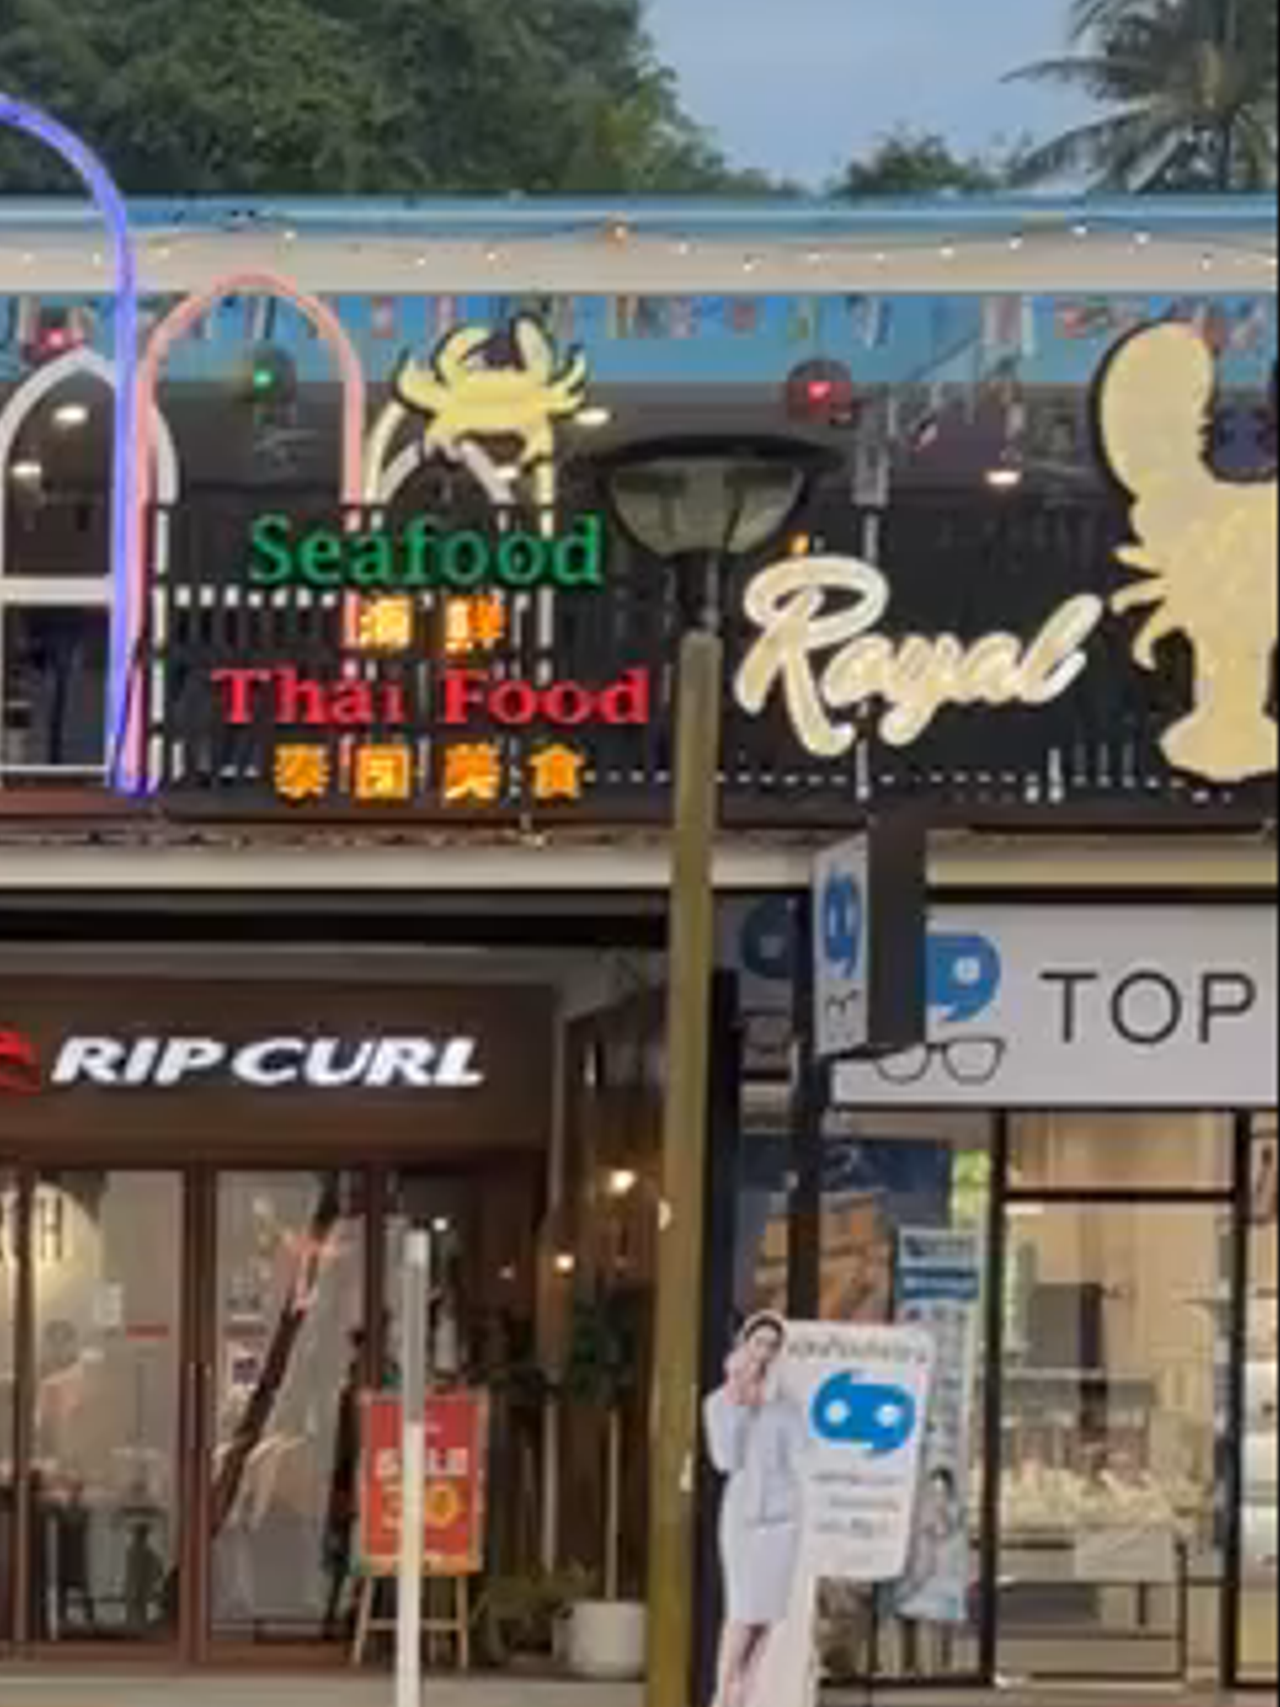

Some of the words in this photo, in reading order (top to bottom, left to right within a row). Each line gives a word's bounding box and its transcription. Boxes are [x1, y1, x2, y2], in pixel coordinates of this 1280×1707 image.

[249, 514, 603, 585] Seafood
[734, 555, 1103, 756] Royal
[211, 668, 405, 725] Thai
[443, 667, 650, 725] Food
[1039, 970, 1257, 1044] TOP
[50, 1036, 226, 1085] RIP
[232, 1036, 484, 1085] CURL
